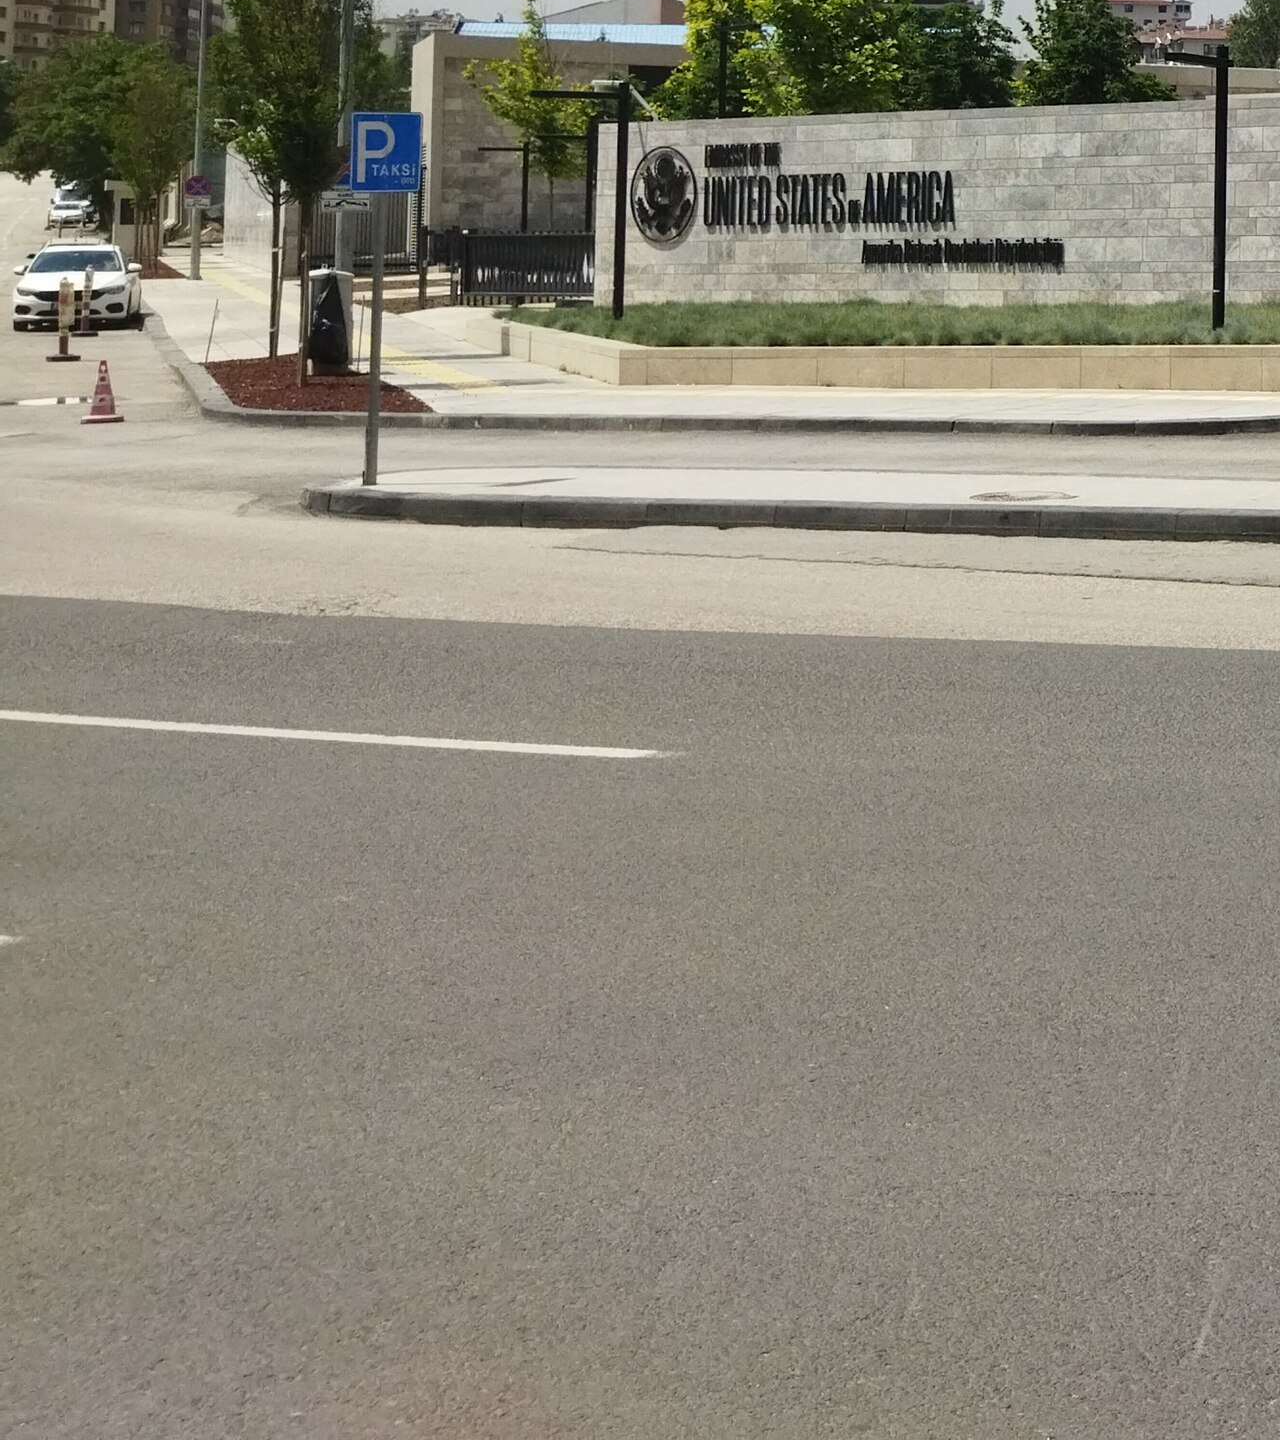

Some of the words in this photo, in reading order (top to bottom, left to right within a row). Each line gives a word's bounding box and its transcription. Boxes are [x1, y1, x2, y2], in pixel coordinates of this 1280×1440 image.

[357, 121, 395, 183] P
[703, 175, 772, 226] UNITED
[776, 172, 847, 225] STATES
[862, 170, 955, 223] AMERICA
